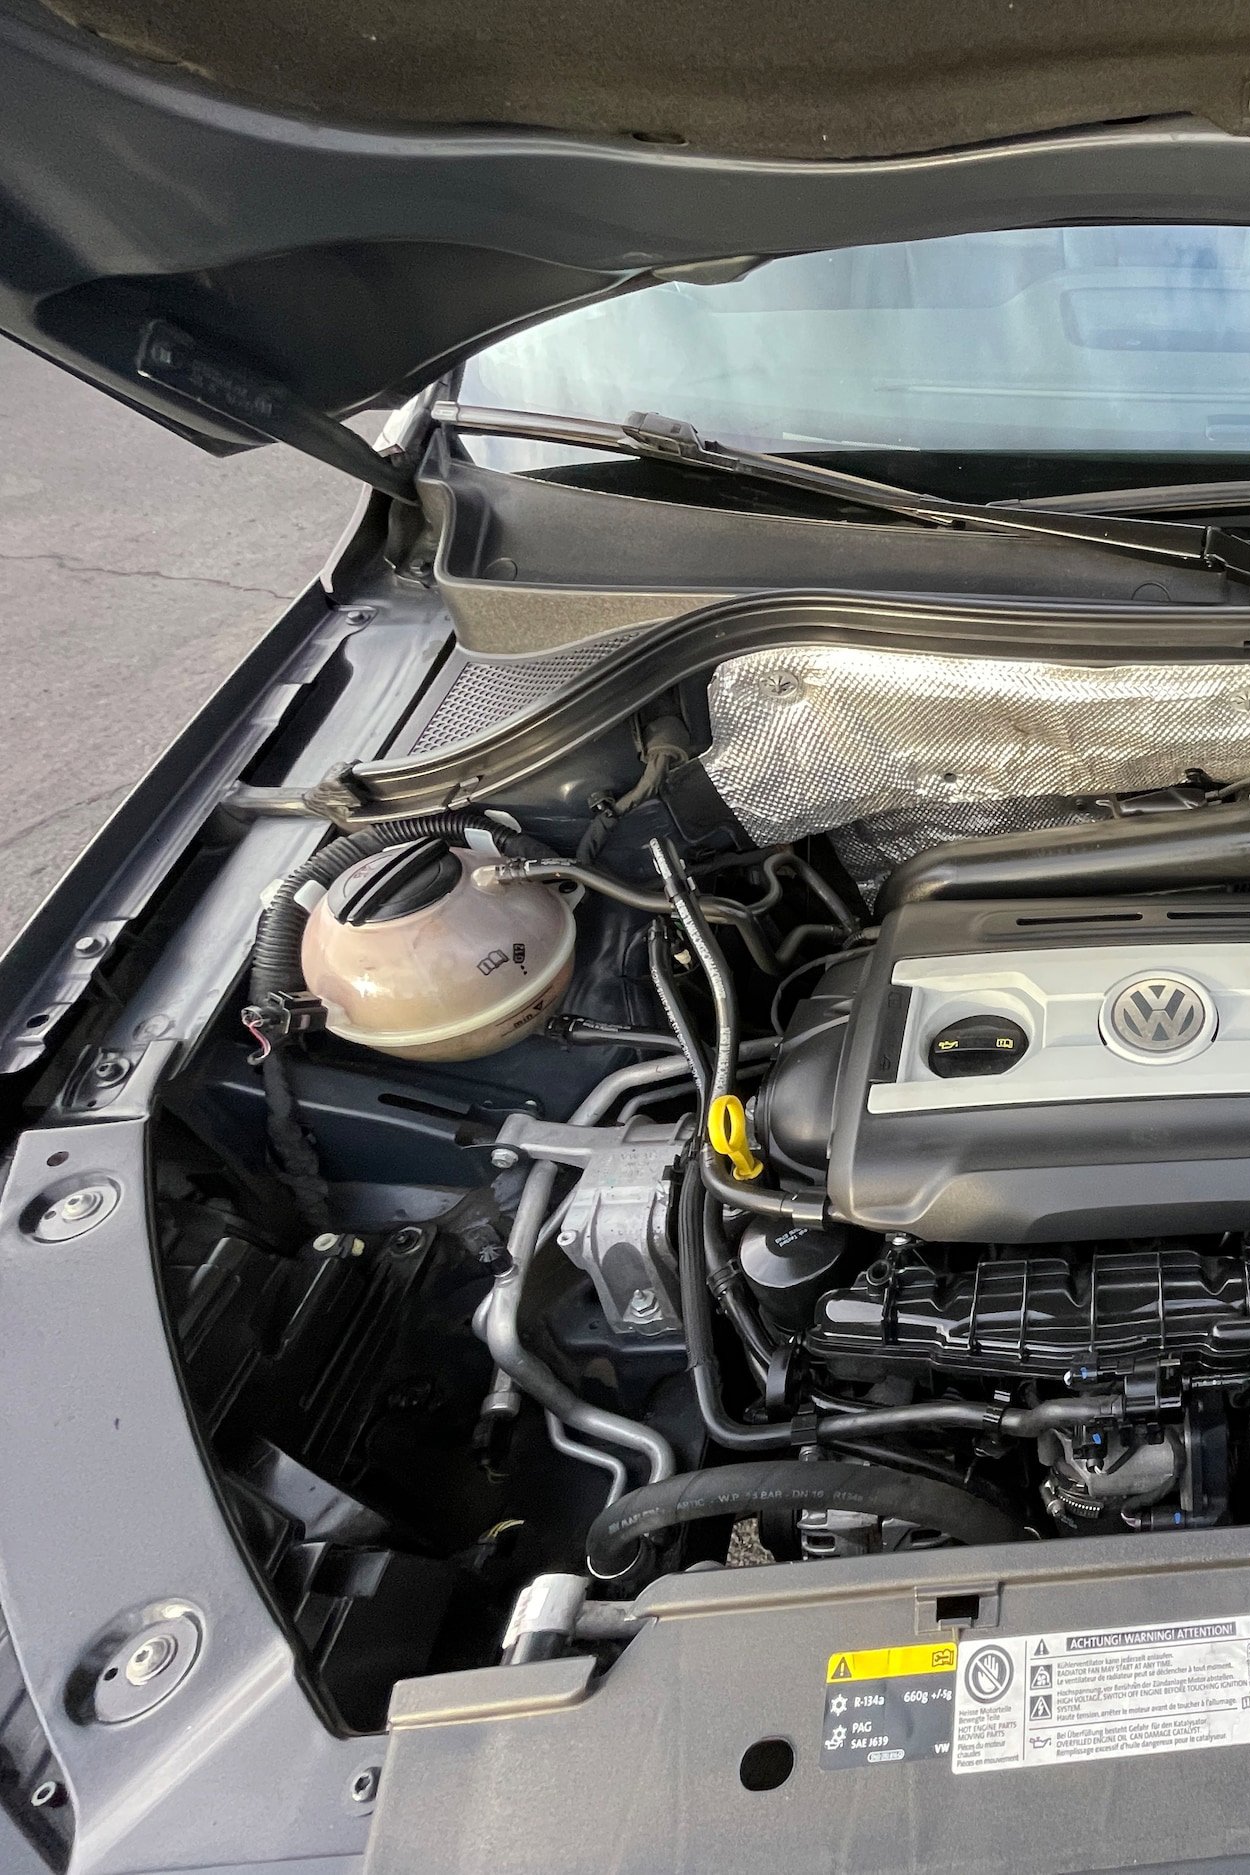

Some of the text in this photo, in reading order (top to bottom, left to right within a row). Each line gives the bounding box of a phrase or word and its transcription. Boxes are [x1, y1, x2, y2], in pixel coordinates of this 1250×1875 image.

[513, 1013, 533, 1029] min
[1070, 1624, 1232, 1648] ACHTUNG! WARNING! ATTENTION!
[854, 1695, 884, 1707] R-134a
[903, 1690, 927, 1705] 660g
[852, 1721, 871, 1733] PAG
[851, 1736, 888, 1748] SAE J639
[934, 1742, 949, 1753] VW
